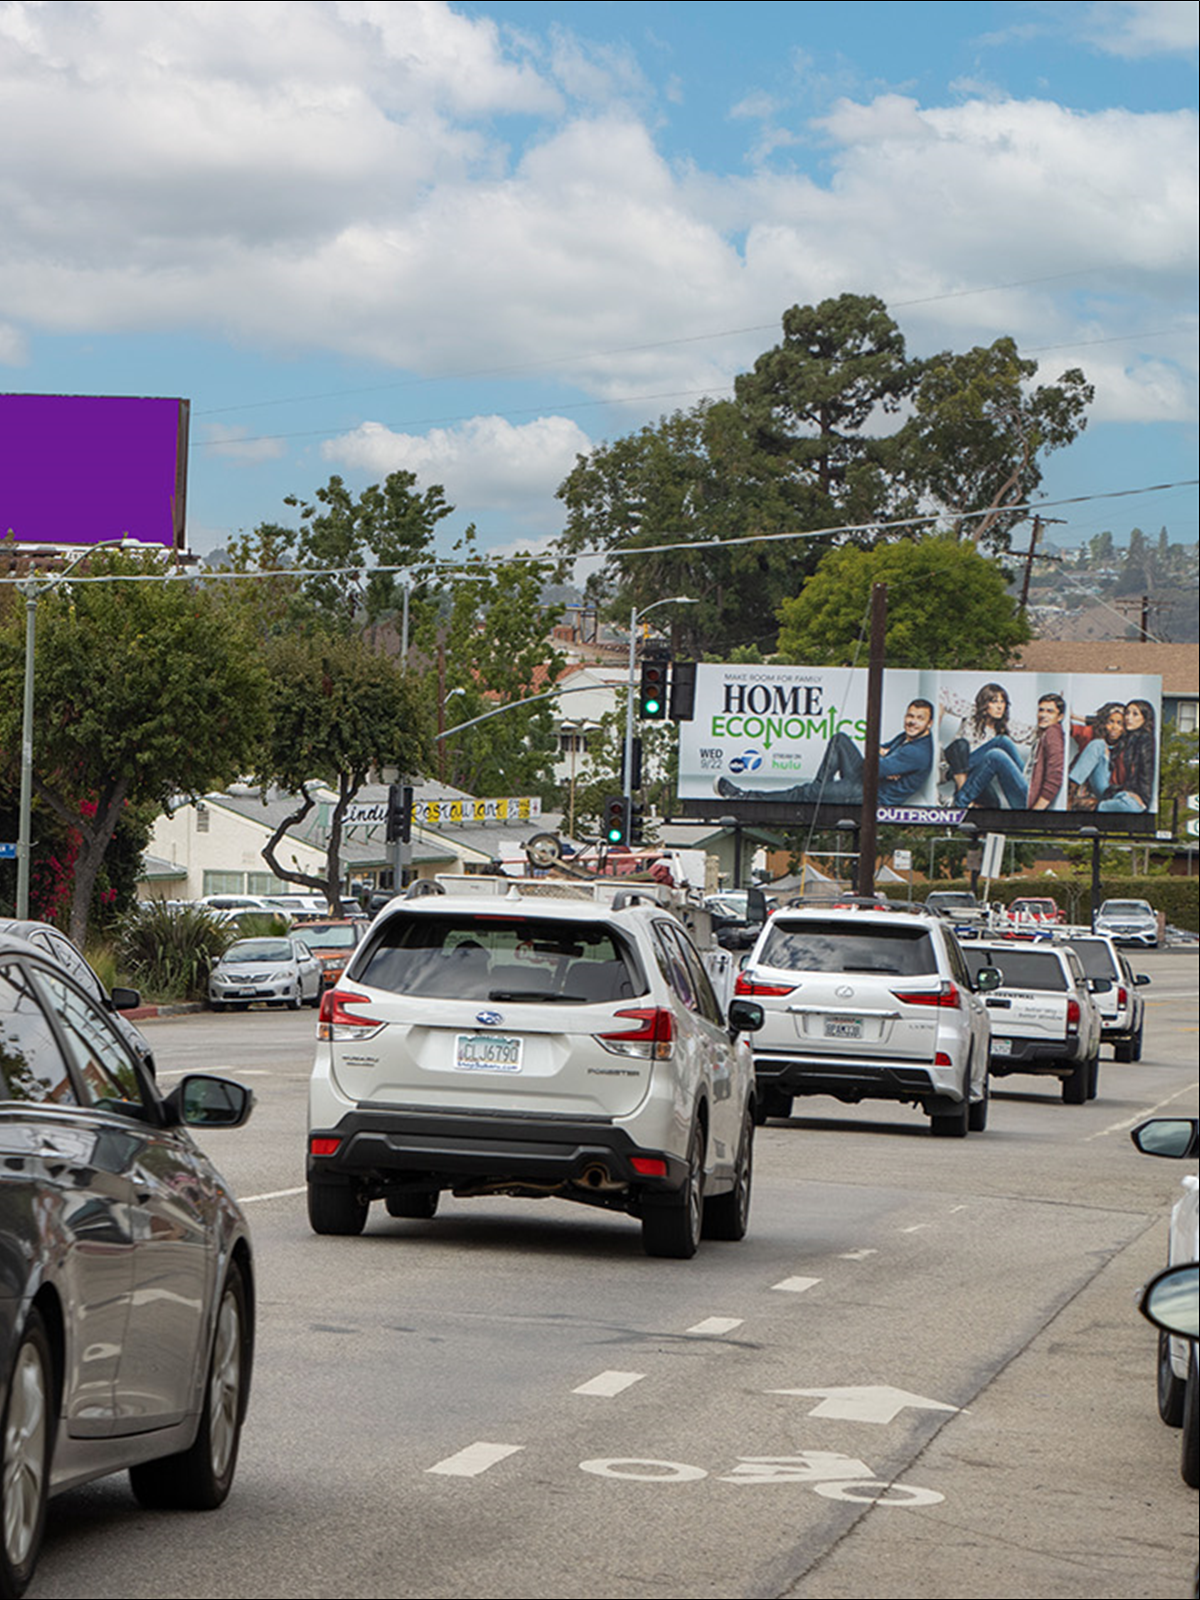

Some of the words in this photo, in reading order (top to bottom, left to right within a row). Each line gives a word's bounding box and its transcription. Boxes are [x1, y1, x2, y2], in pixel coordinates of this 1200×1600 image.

[724, 673, 747, 681] MAKE
[749, 674, 775, 682] ROOM
[795, 675, 823, 683] FAMILY
[722, 683, 824, 716] HOME
[711, 709, 867, 747] ECONOMICS
[700, 748, 724, 759] WED
[701, 759, 723, 769] 9/22
[772, 759, 802, 770] hulu
[412, 798, 505, 822] Restaurant
[876, 807, 961, 822] OUTFRONT
